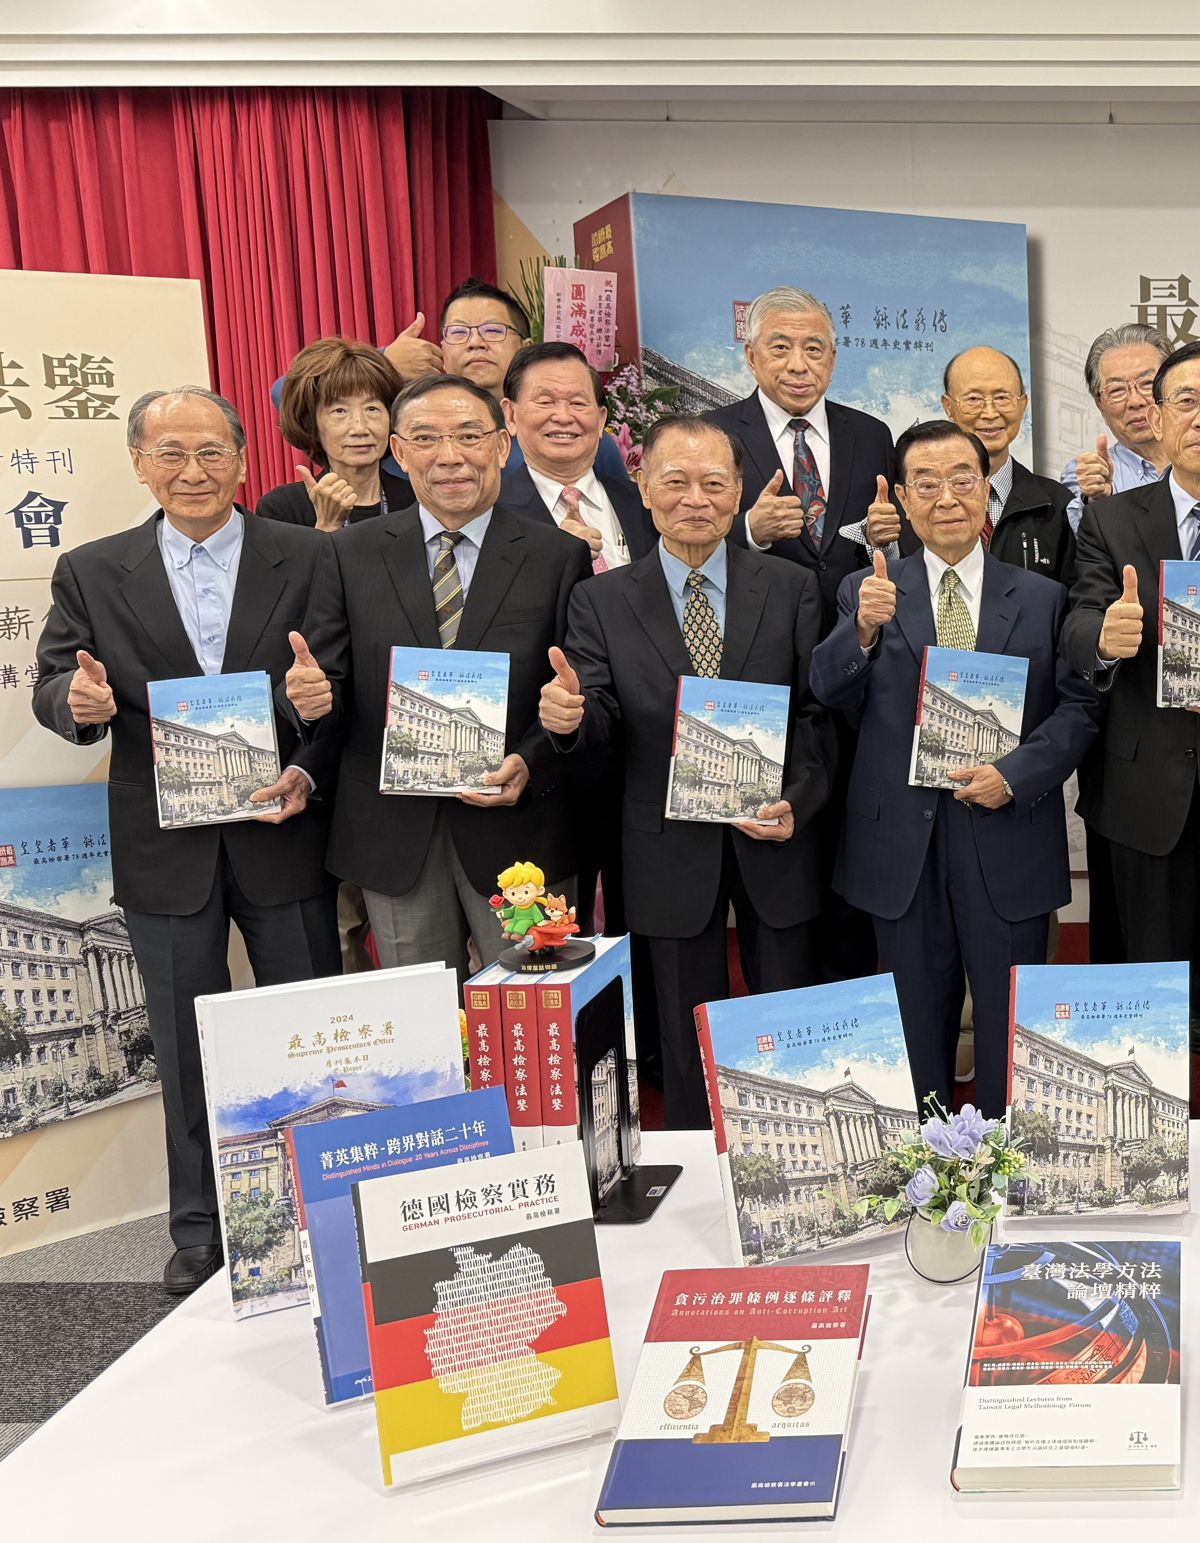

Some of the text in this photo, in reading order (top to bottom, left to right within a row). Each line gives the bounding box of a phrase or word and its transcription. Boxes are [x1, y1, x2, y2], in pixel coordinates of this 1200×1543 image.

[0, 448, 73, 475] 特刊
[5, 490, 69, 549] 會
[329, 1014, 354, 1024] 2024
[288, 1021, 394, 1050] 最高檢察署
[511, 1022, 529, 1113] 最高檢察法鑒
[546, 1022, 565, 1112] 最高檢察法鑒
[321, 1167, 362, 1181] Distinguished
[363, 1163, 381, 1172] Minds
[424, 1151, 439, 1159] Years
[400, 1173, 556, 1222] 德國檢察實務
[402, 1195, 559, 1232] GERMAN PROSECUTORIAL PRACTICE
[1021, 1262, 1162, 1280] 臺灣法學方法
[673, 1289, 853, 1306] 貪污治罪條例逐條評釋
[1066, 1281, 1161, 1300] 論壇精粹
[1004, 1403, 1022, 1411] Legal
[1023, 1402, 1067, 1410] Methodology
